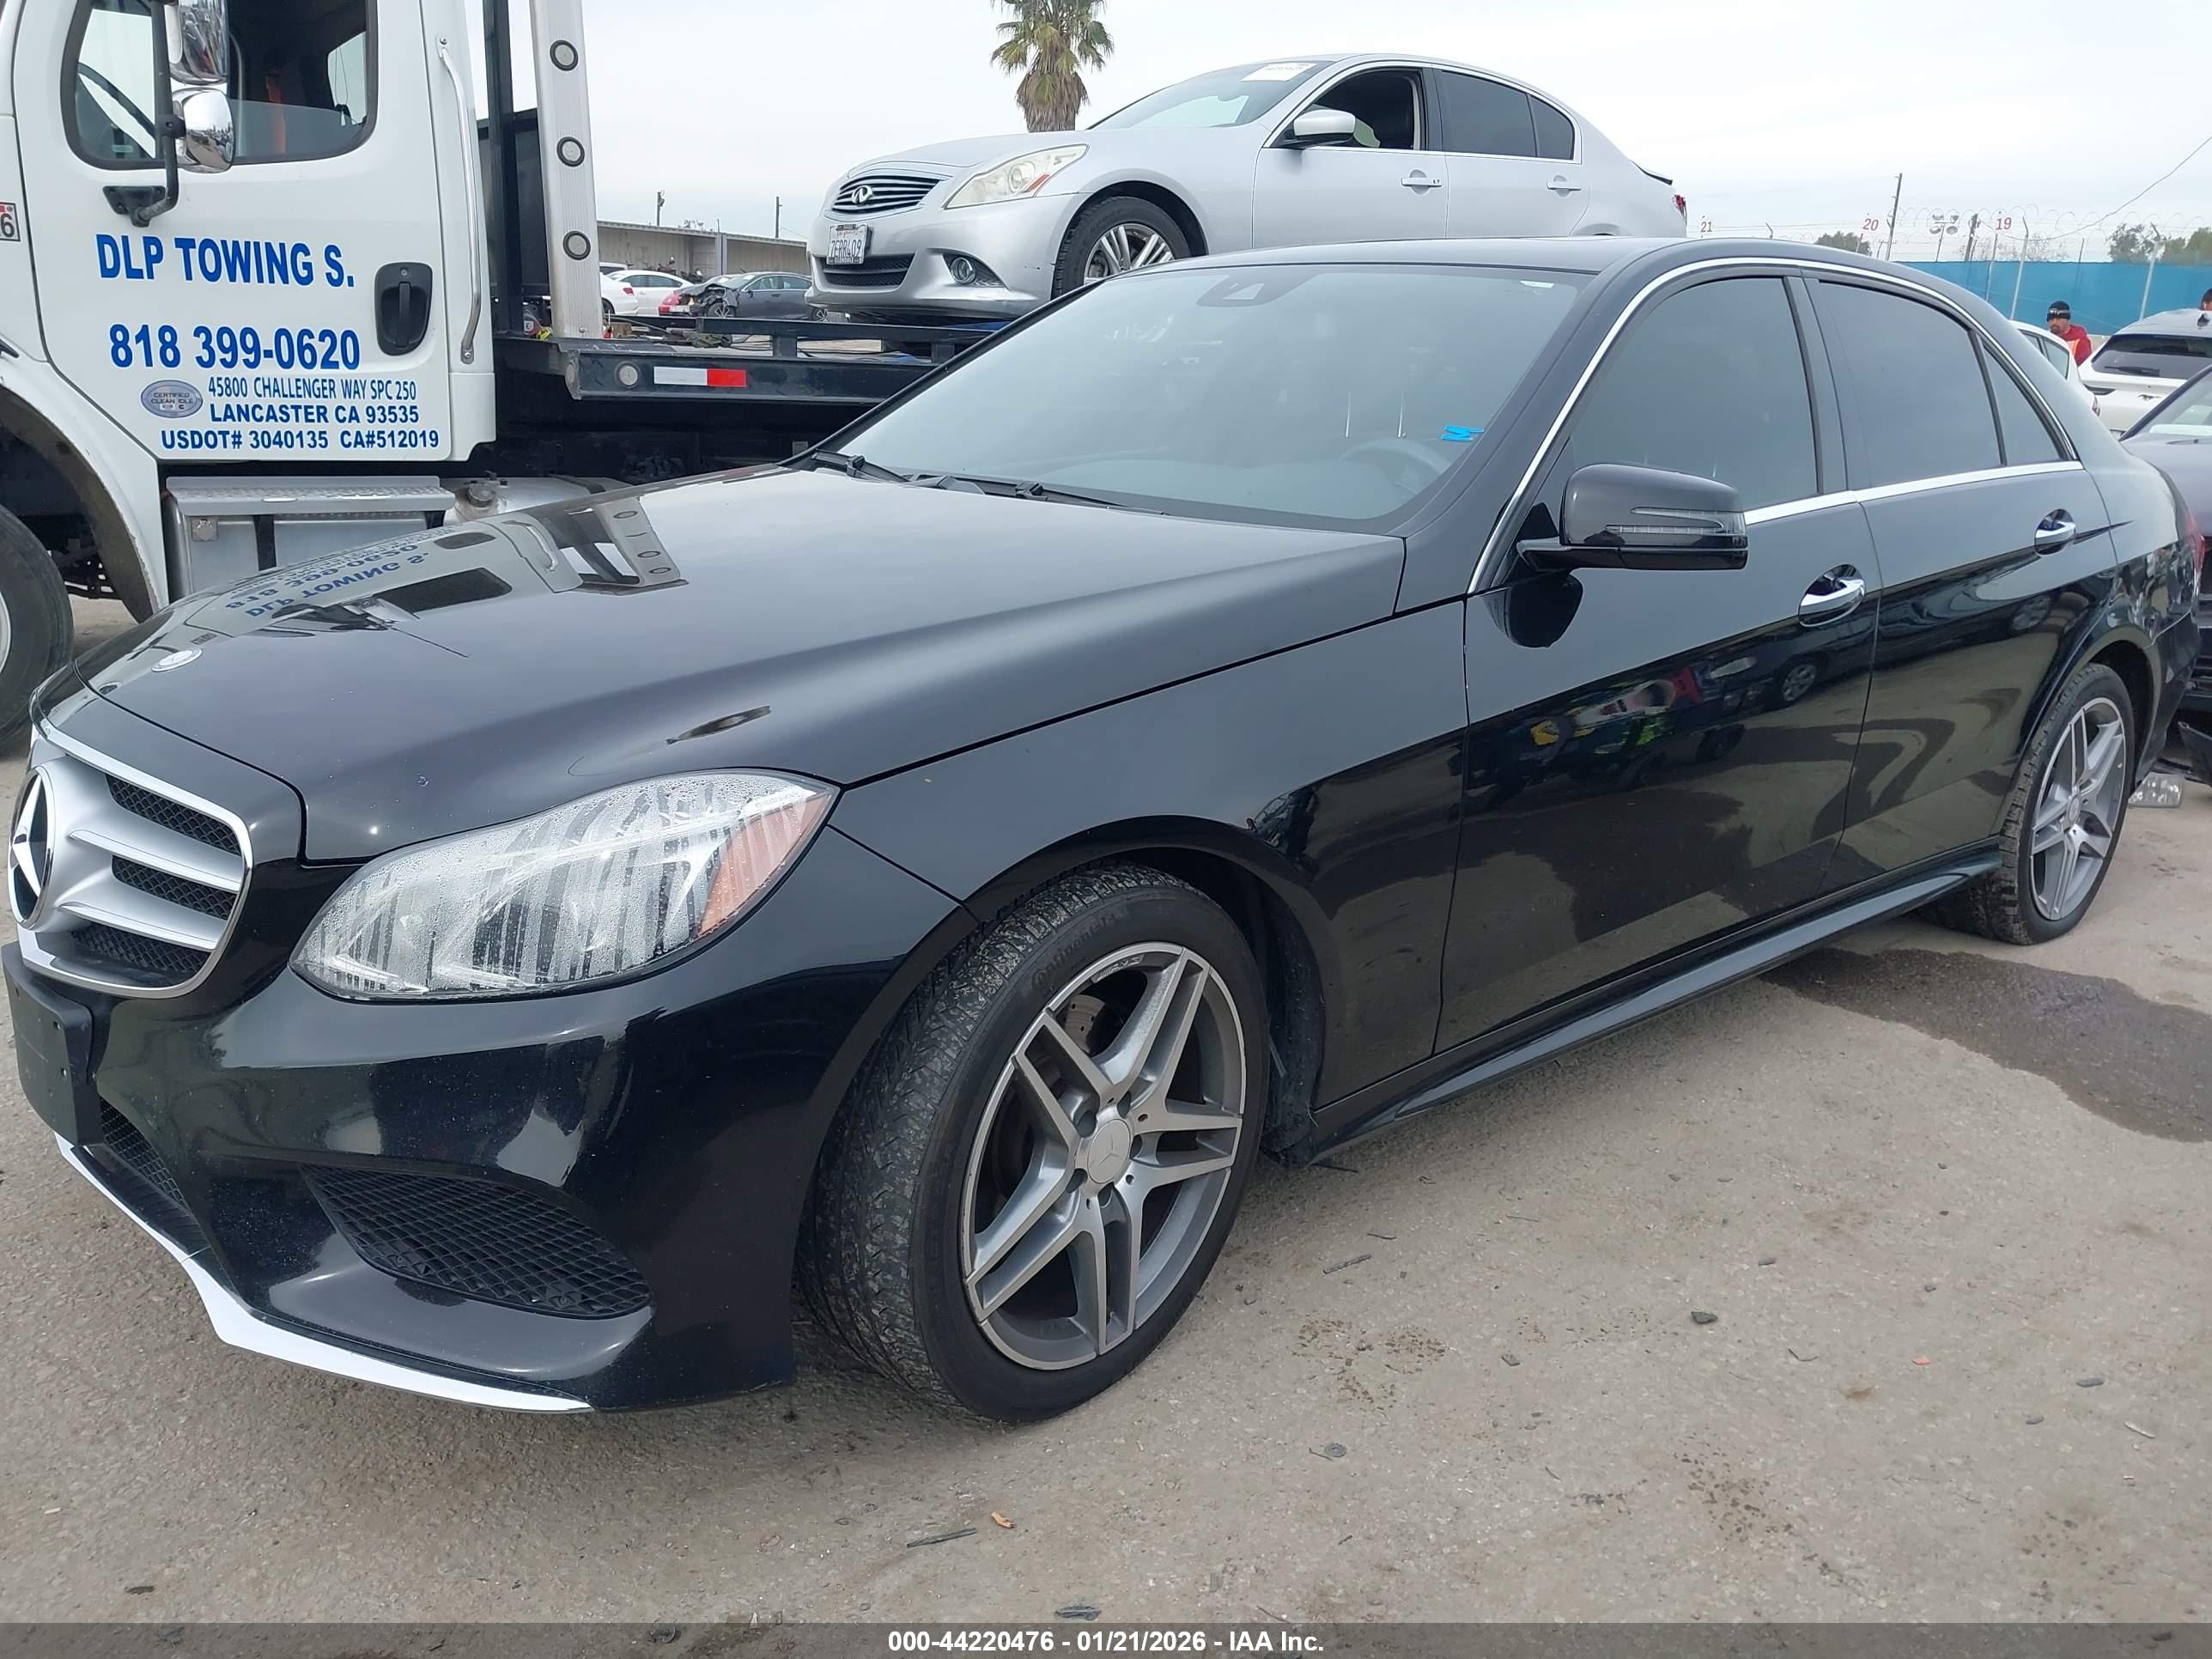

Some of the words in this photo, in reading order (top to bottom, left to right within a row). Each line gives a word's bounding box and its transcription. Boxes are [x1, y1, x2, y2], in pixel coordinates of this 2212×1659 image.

[1700, 221, 1712, 233] 21
[1863, 218, 1879, 231] 20
[1996, 217, 2012, 230] 19
[96, 234, 164, 279] DLP
[174, 237, 314, 286] TOWING
[324, 245, 355, 288] S.
[109, 324, 181, 368] 818
[193, 325, 360, 370] 399-0620
[209, 376, 248, 398] 45800
[254, 377, 337, 399] CHALLENGER
[341, 379, 367, 400] WAY
[370, 380, 393, 400] SPC
[395, 380, 416, 401] 250
[210, 404, 329, 423] LANCASTER
[335, 404, 361, 423] CA
[366, 405, 419, 423] 93535
[161, 429, 243, 450] USDOT#
[249, 430, 329, 449] 3040135
[340, 429, 439, 449] CA#512019
